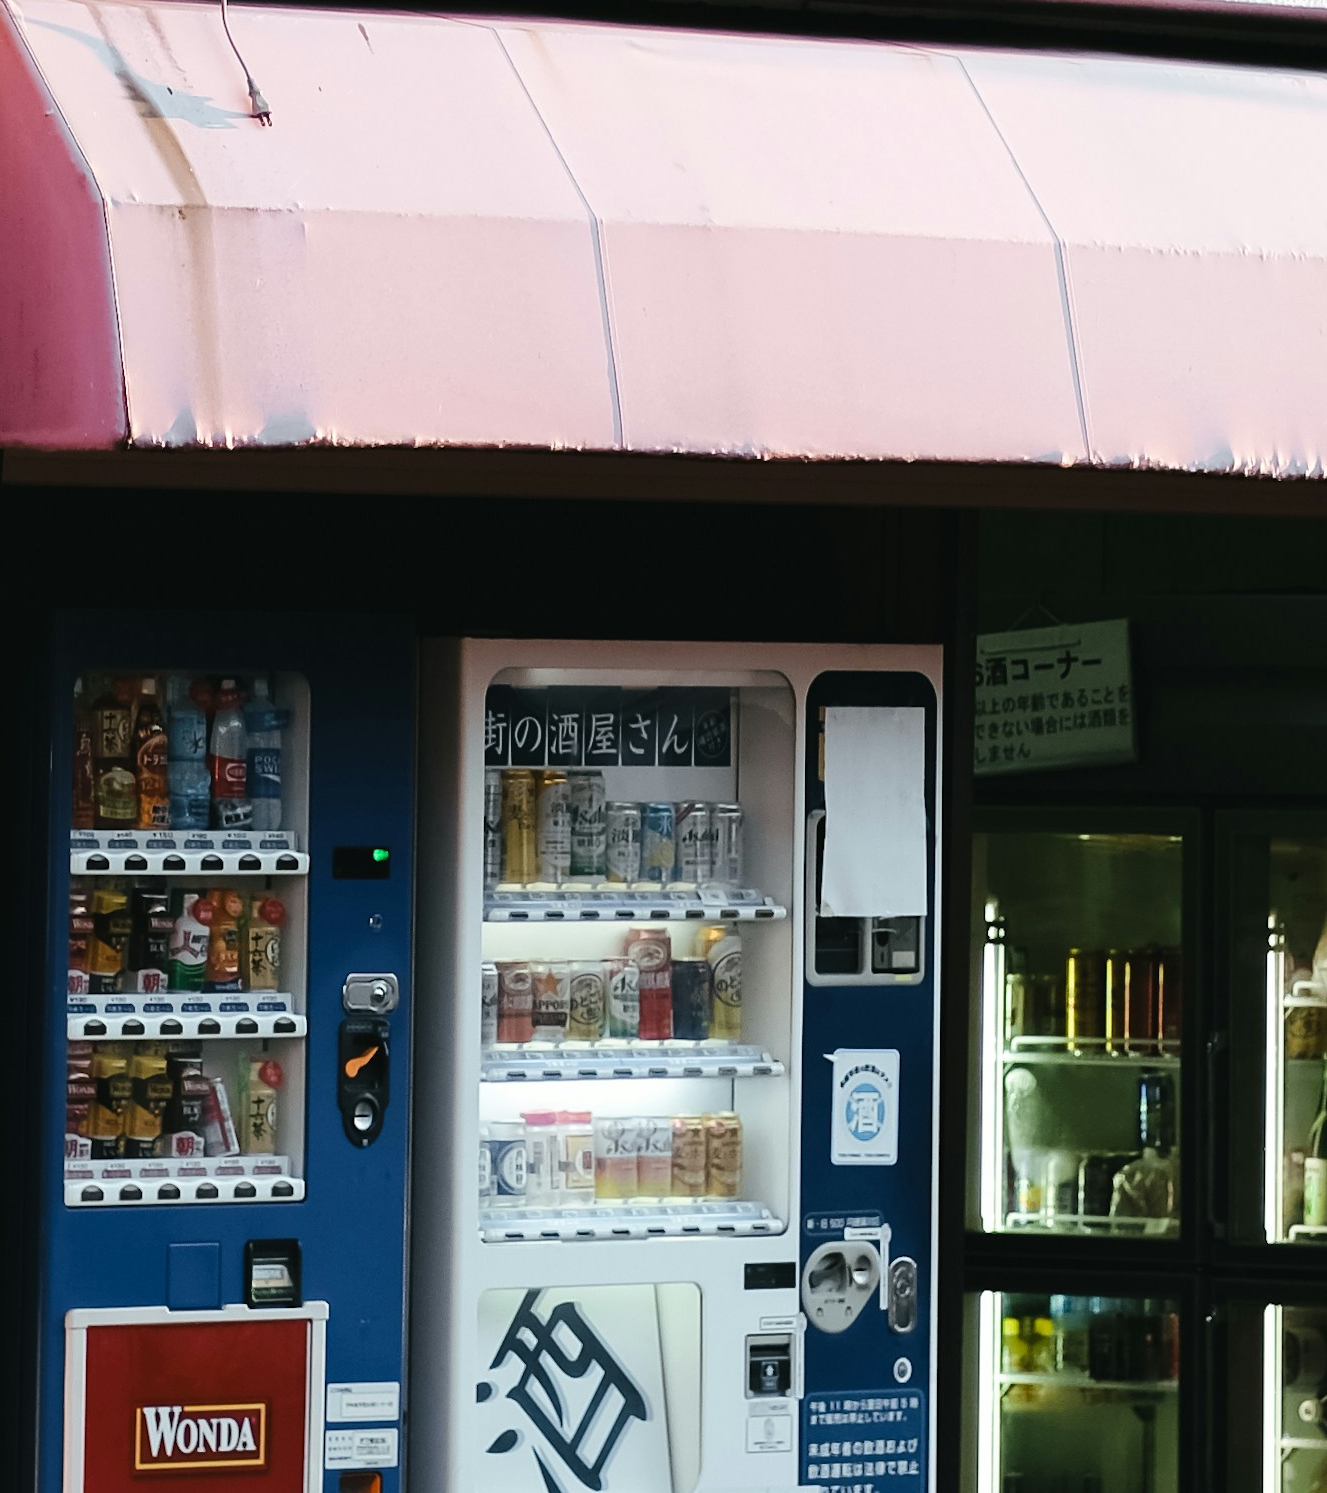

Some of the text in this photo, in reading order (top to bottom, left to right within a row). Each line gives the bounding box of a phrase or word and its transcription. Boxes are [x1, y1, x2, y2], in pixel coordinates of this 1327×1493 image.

[485, 710, 688, 756] 街の酒屋さん
[142, 1405, 257, 1458] WONDA
